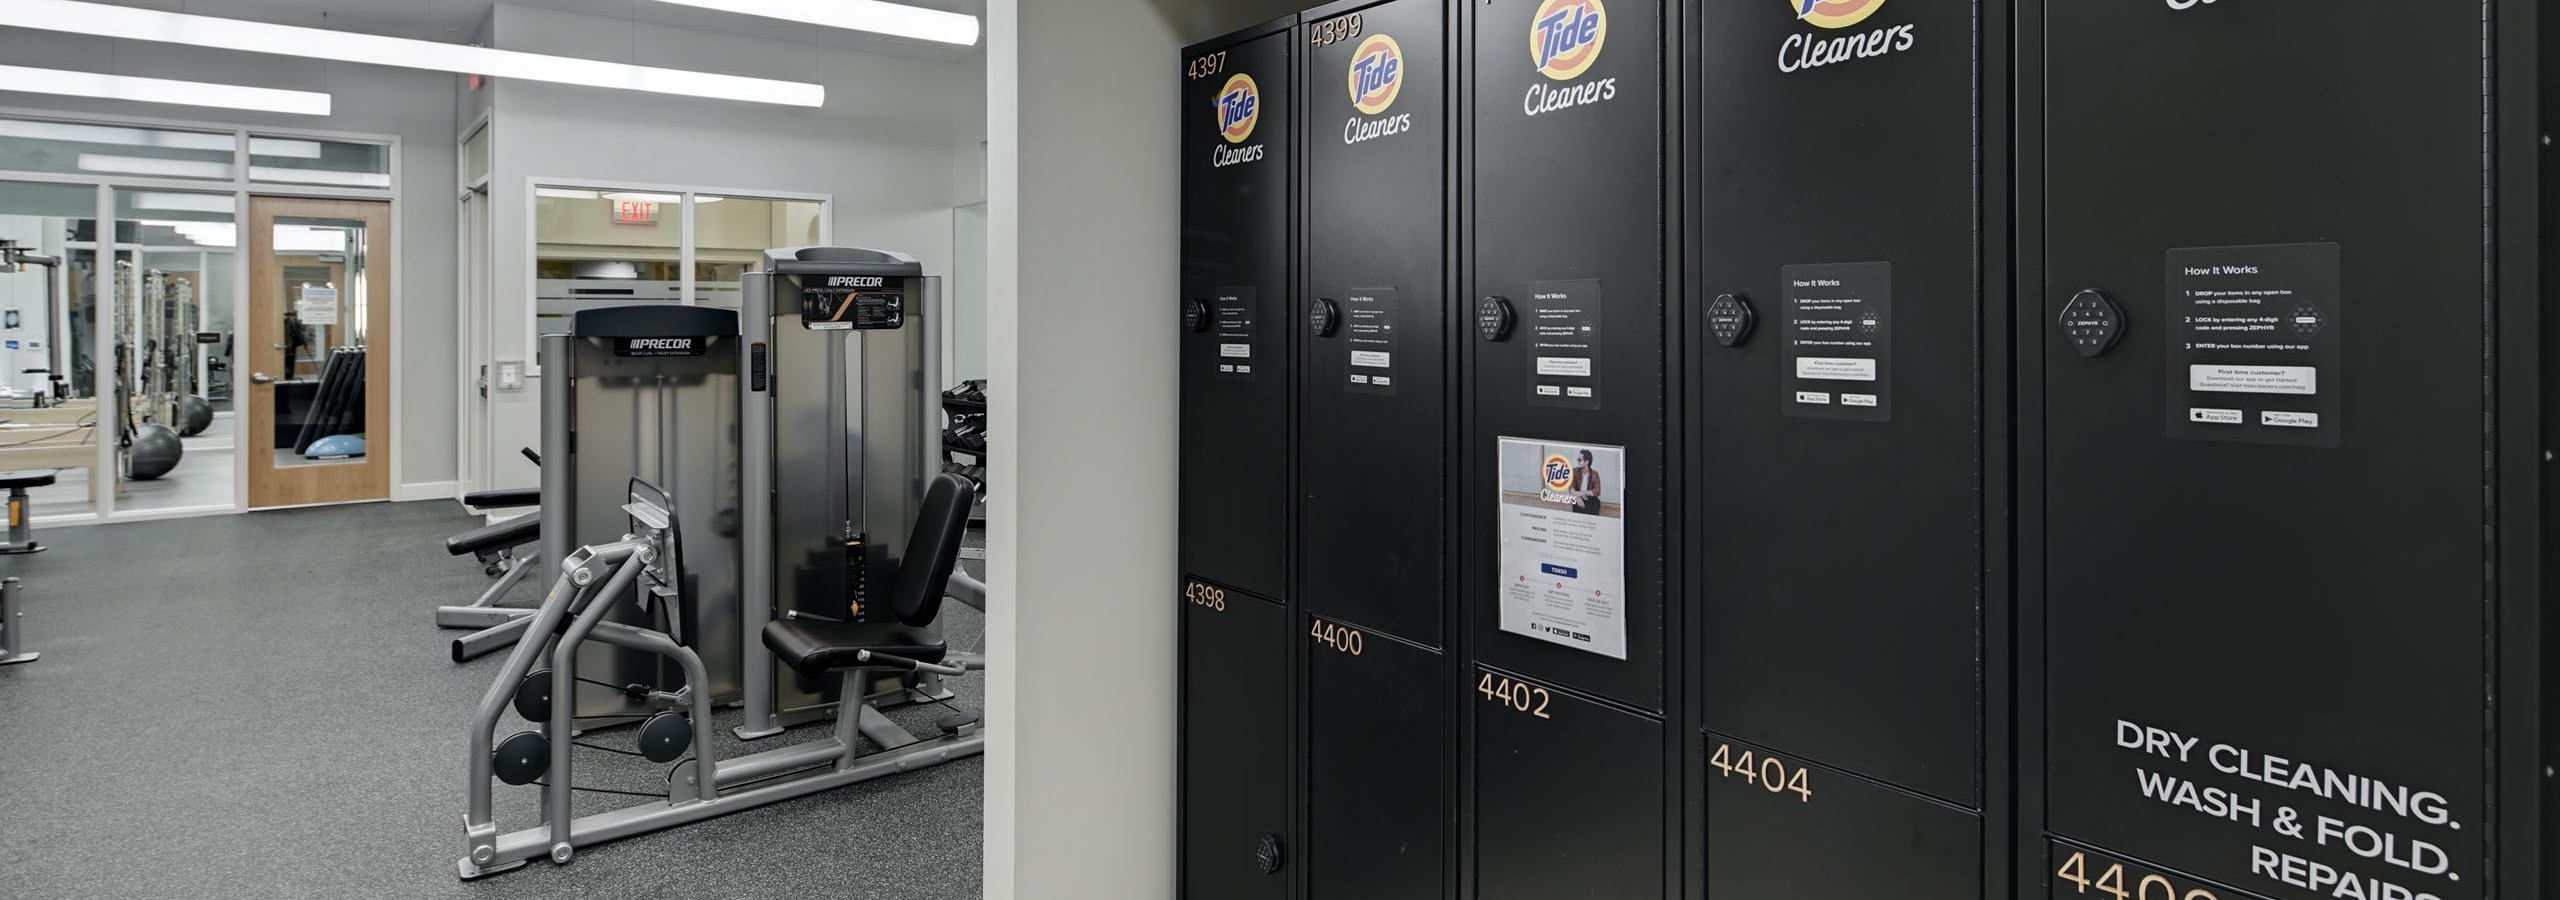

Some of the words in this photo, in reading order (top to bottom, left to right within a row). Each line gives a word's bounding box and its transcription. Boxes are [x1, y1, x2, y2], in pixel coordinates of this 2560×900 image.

[1311, 12, 1363, 48] 4399
[1537, 2, 1600, 72] Tide
[1778, 24, 1914, 73] Cleaners
[1188, 51, 1227, 80] 4397
[1353, 49, 1398, 107] Tide
[1220, 86, 1256, 135] Tide
[1524, 78, 1616, 116] Cleaners
[1344, 112, 1410, 144] Cleaners
[1212, 142, 1264, 168] Cleaners
[622, 201, 652, 222] EXIT
[836, 277, 883, 287] PRECOR
[2185, 267, 2210, 275] How
[2223, 266, 2258, 274] Works
[640, 339, 691, 349] PRECOR
[1546, 463, 1570, 485] Tide
[1540, 488, 1577, 504] Cleaners
[1186, 582, 1225, 612] 4398
[1311, 619, 1362, 656] 4400
[1478, 673, 1550, 719] 4402
[1710, 744, 1814, 802] 4404
[2117, 719, 2200, 762] DRY
[2208, 744, 2461, 830] CLEANING.
[2136, 768, 2260, 828] WASH
[2272, 806, 2304, 840] &
[2317, 815, 2460, 881] FOLD.
[2058, 852, 2218, 900] 440
[2252, 845, 2442, 900] REPAIR
